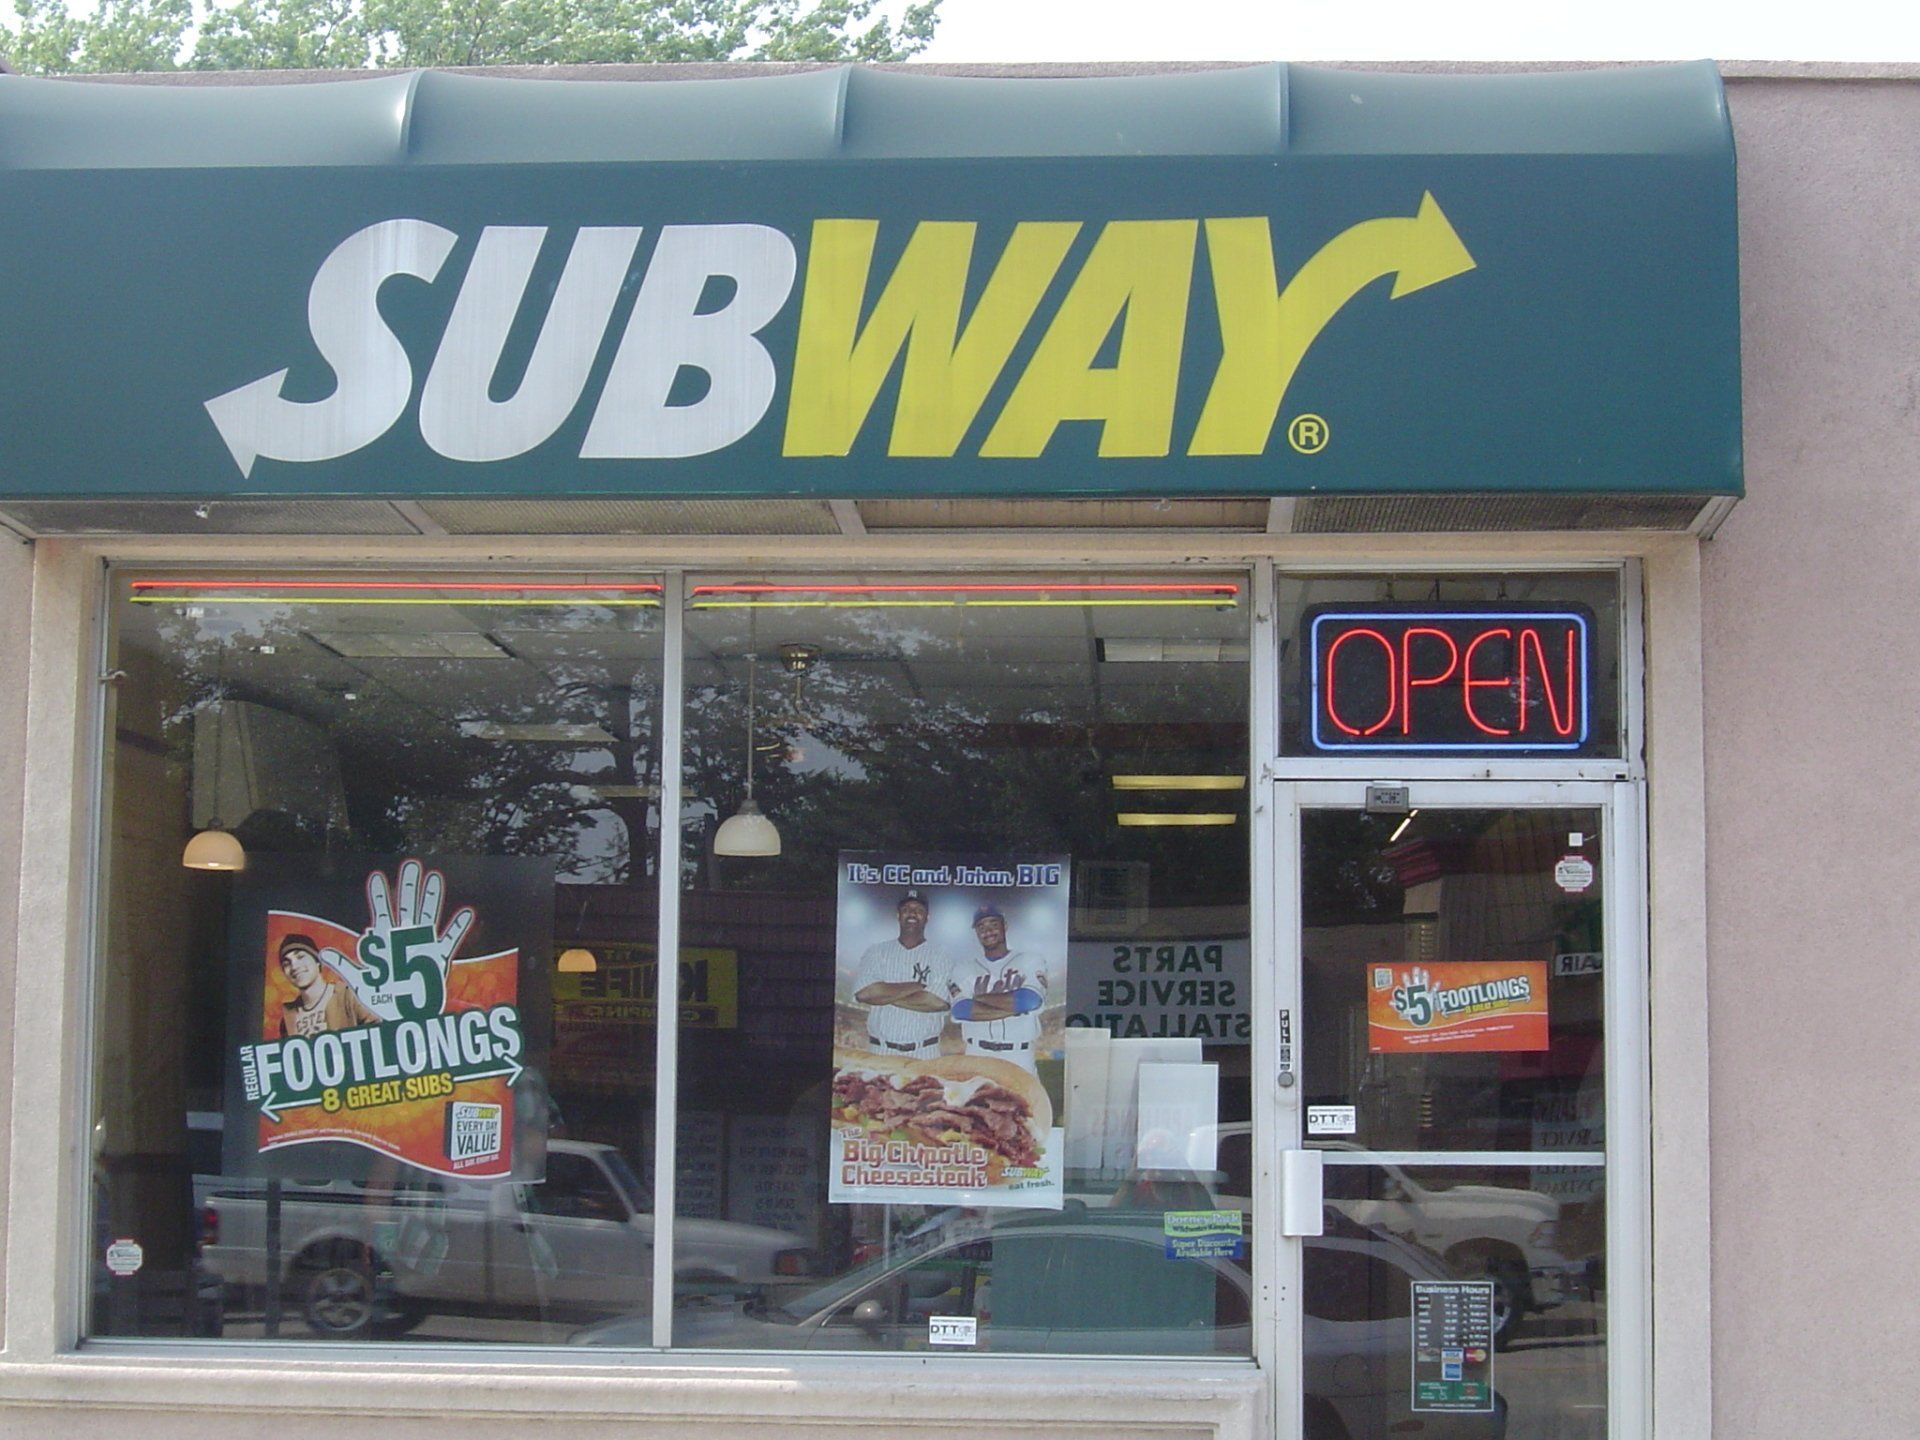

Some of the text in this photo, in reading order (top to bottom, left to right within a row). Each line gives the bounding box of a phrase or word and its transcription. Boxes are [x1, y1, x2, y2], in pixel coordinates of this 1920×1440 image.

[204, 190, 1478, 479] SUBWAY
[1326, 628, 1574, 736] OPEN
[847, 863, 1061, 887] It's CC and Johan BIG
[359, 926, 445, 1018] $5
[371, 993, 393, 1006] EACH
[1439, 976, 1530, 1010] FOOTLONGS
[254, 1005, 522, 1097] FOOTLONGS
[240, 1045, 259, 1100] REGULAR
[322, 1073, 454, 1111] 8 GREAT SUBS
[456, 1120, 498, 1131] EVERY DAY
[457, 1133, 497, 1155] VALUE
[842, 1140, 986, 1169] Big Chipotle
[841, 1165, 988, 1188] Cheesesteak
[1001, 1166, 1049, 1179] SUBWAY
[1415, 1285, 1490, 1294] Business Hours
